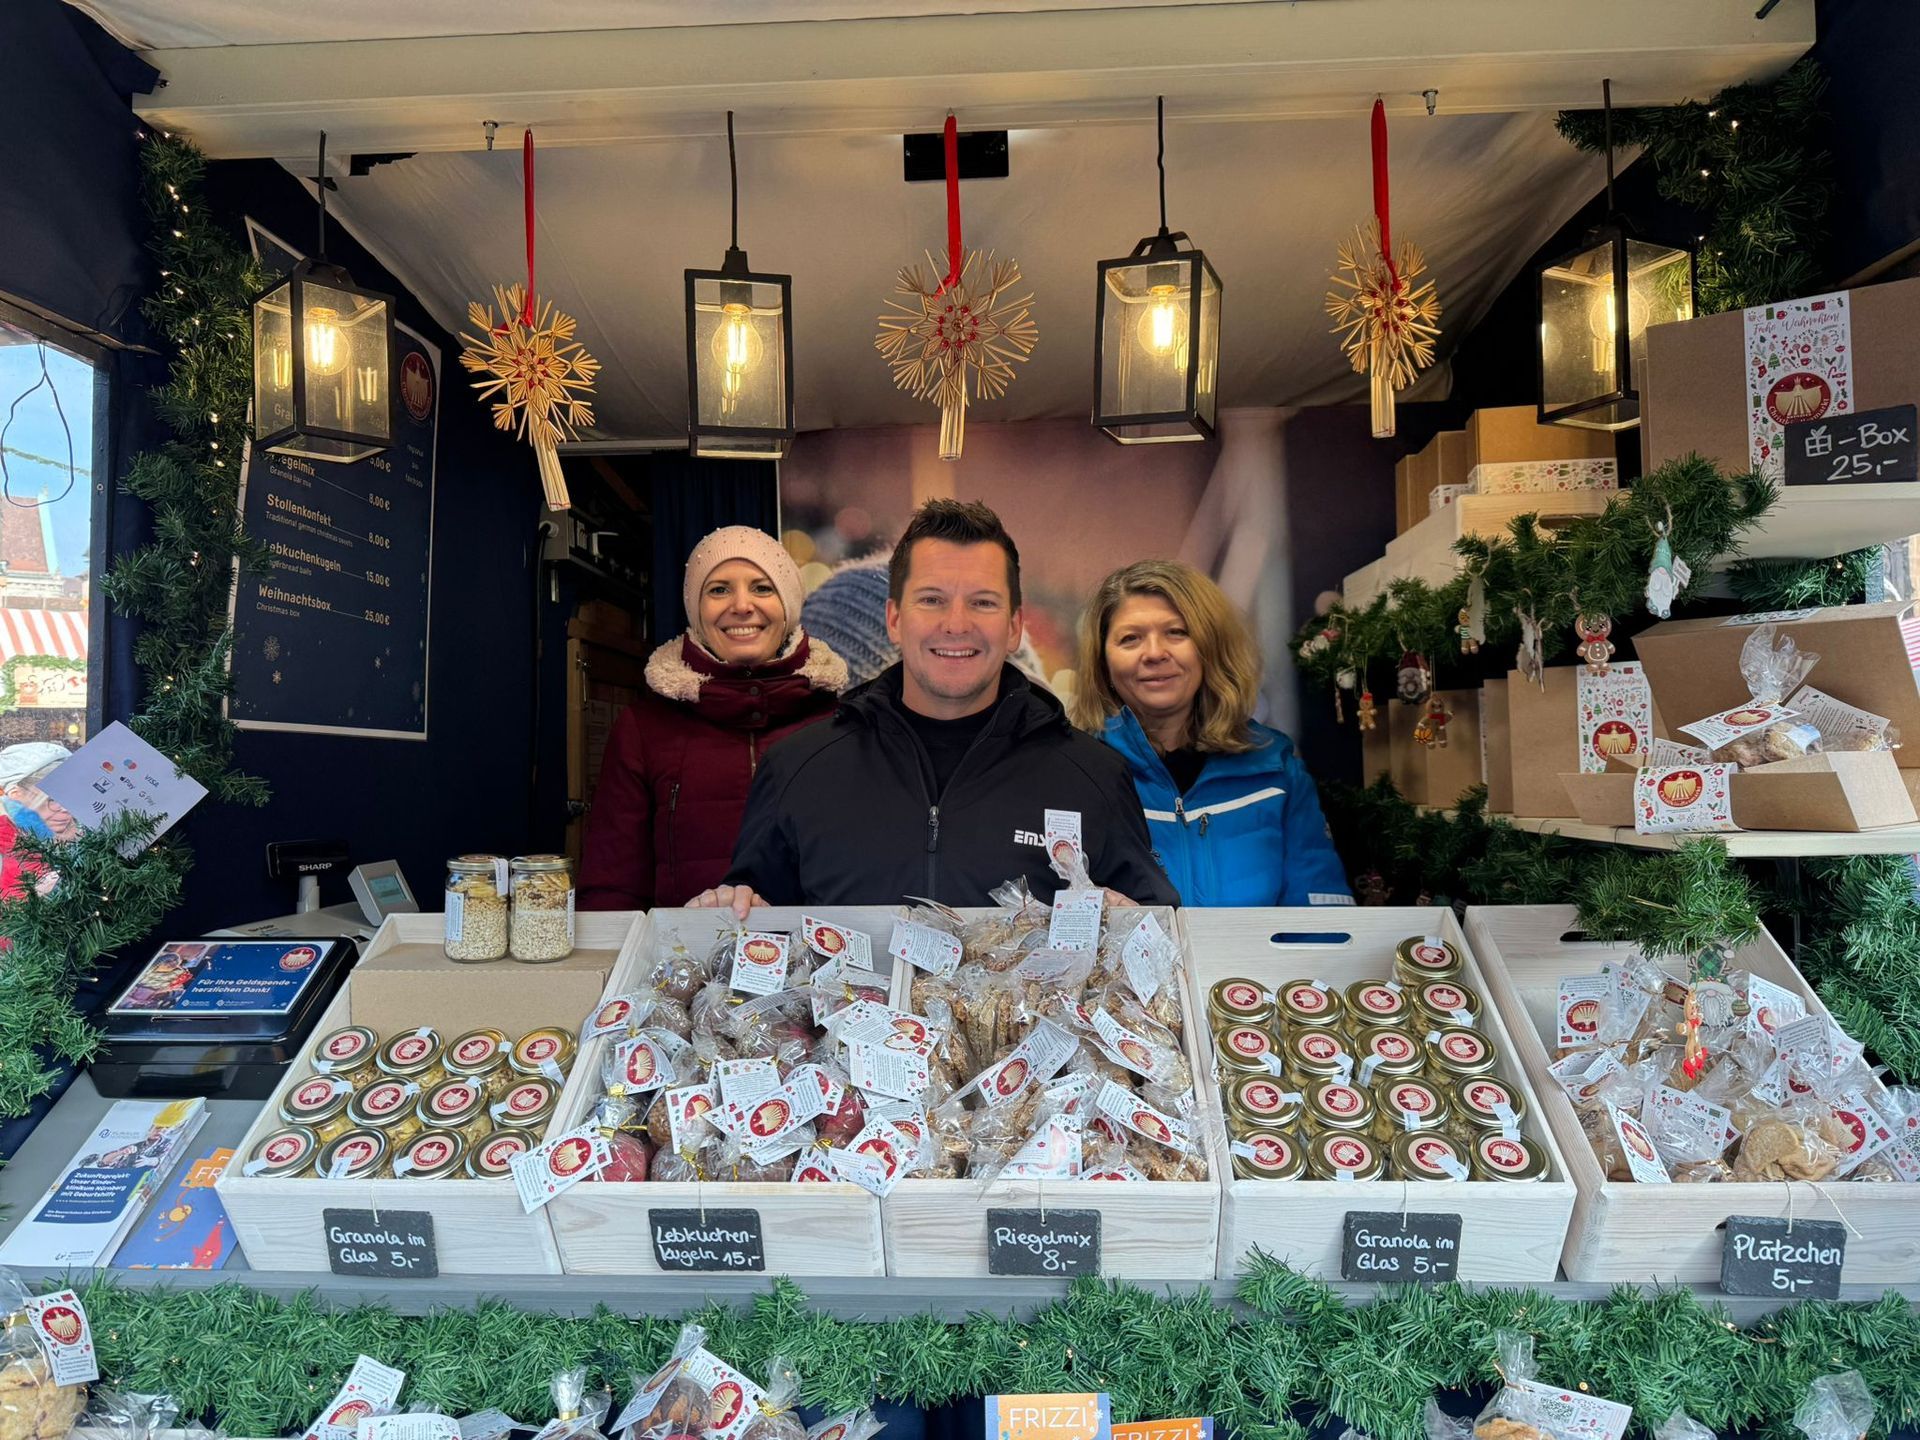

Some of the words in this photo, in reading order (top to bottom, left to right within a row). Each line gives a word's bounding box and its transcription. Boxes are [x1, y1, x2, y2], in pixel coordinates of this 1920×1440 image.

[1826, 453, 1899, 481] 25,-
[267, 493, 332, 527] Stollenkonfekt
[258, 584, 332, 611] Weihnachtsbox
[256, 601, 289, 616] Christmas
[298, 862, 332, 871] SHARP
[330, 1226, 405, 1246] Granola
[408, 1232, 426, 1247] im
[994, 1227, 1092, 1255] Riegelmix
[1355, 1229, 1432, 1250] Granola
[1435, 1236, 1455, 1250] im
[340, 1247, 379, 1264] Glas
[1356, 1252, 1400, 1272] Glas
[1009, 1407, 1088, 1429] FRIZZI
